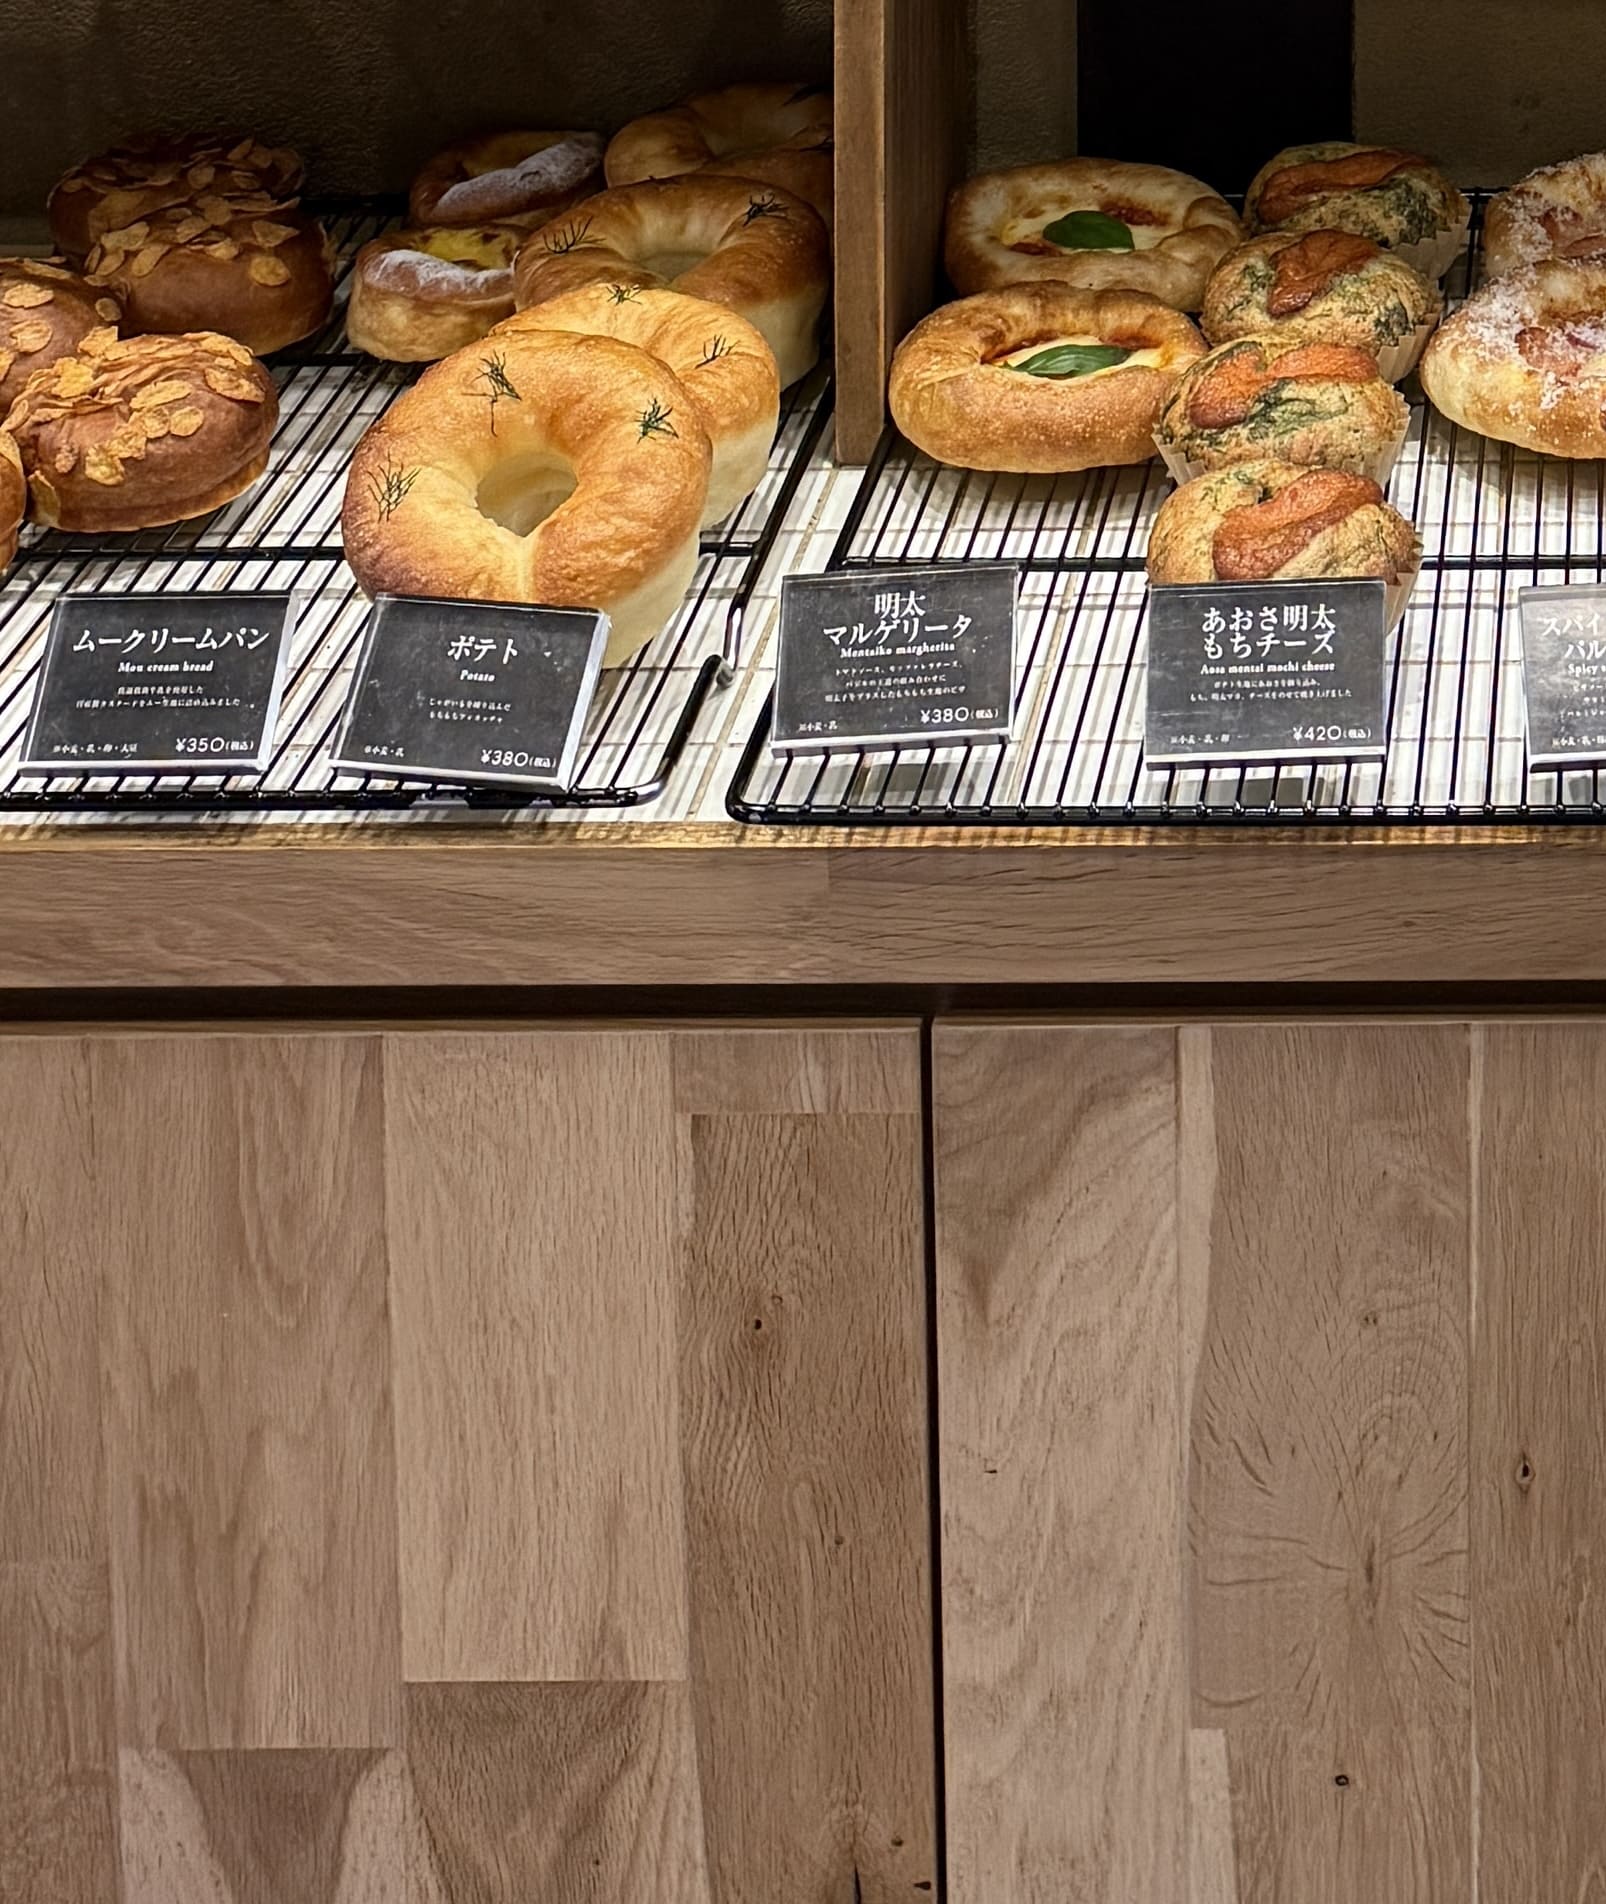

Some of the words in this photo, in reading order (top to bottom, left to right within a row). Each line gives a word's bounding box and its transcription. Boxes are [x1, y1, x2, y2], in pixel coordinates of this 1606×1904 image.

[874, 589, 927, 619] 明太
[822, 614, 973, 646] マルゲリータ
[1201, 603, 1337, 634] あおさ明太
[72, 627, 270, 654] ムークリームパン
[446, 634, 519, 664] ポテト
[839, 645, 892, 659] Mentaiko
[895, 642, 955, 657] margherita
[1203, 630, 1336, 660] もちチーズ
[117, 661, 144, 673] Mou
[146, 662, 179, 673] cream
[182, 660, 214, 673] bread
[459, 669, 496, 683] Potato
[1200, 663, 1226, 675] Aosa
[1228, 662, 1264, 674] mentai
[1267, 661, 1299, 673] mochi
[1301, 660, 1336, 672] cheese
[1567, 663, 1598, 677] Spicy
